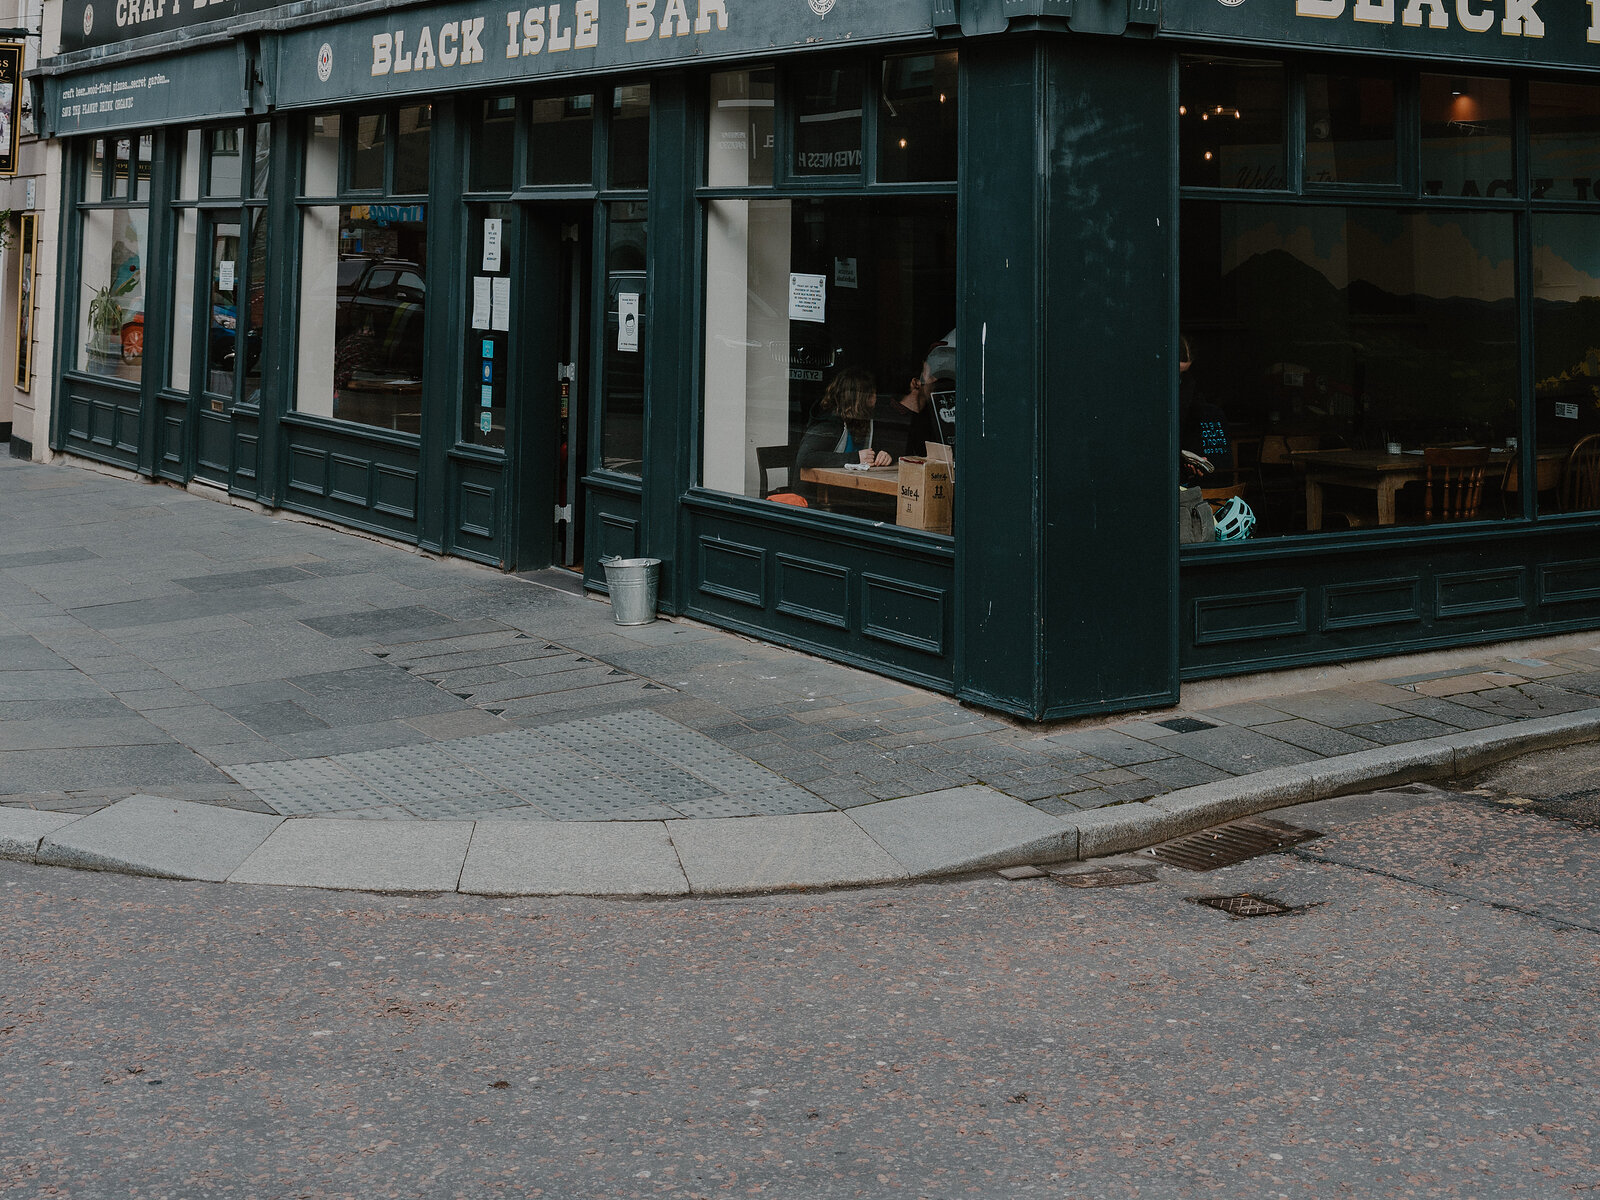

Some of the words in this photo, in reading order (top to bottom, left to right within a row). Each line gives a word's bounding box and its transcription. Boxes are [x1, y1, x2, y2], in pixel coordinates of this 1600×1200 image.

[371, 16, 486, 76] BLACK
[62, 87, 75, 99] craft
[82, 102, 98, 115] PLANET
[99, 100, 114, 112] DRINK
[115, 96, 134, 111] ORGANIC
